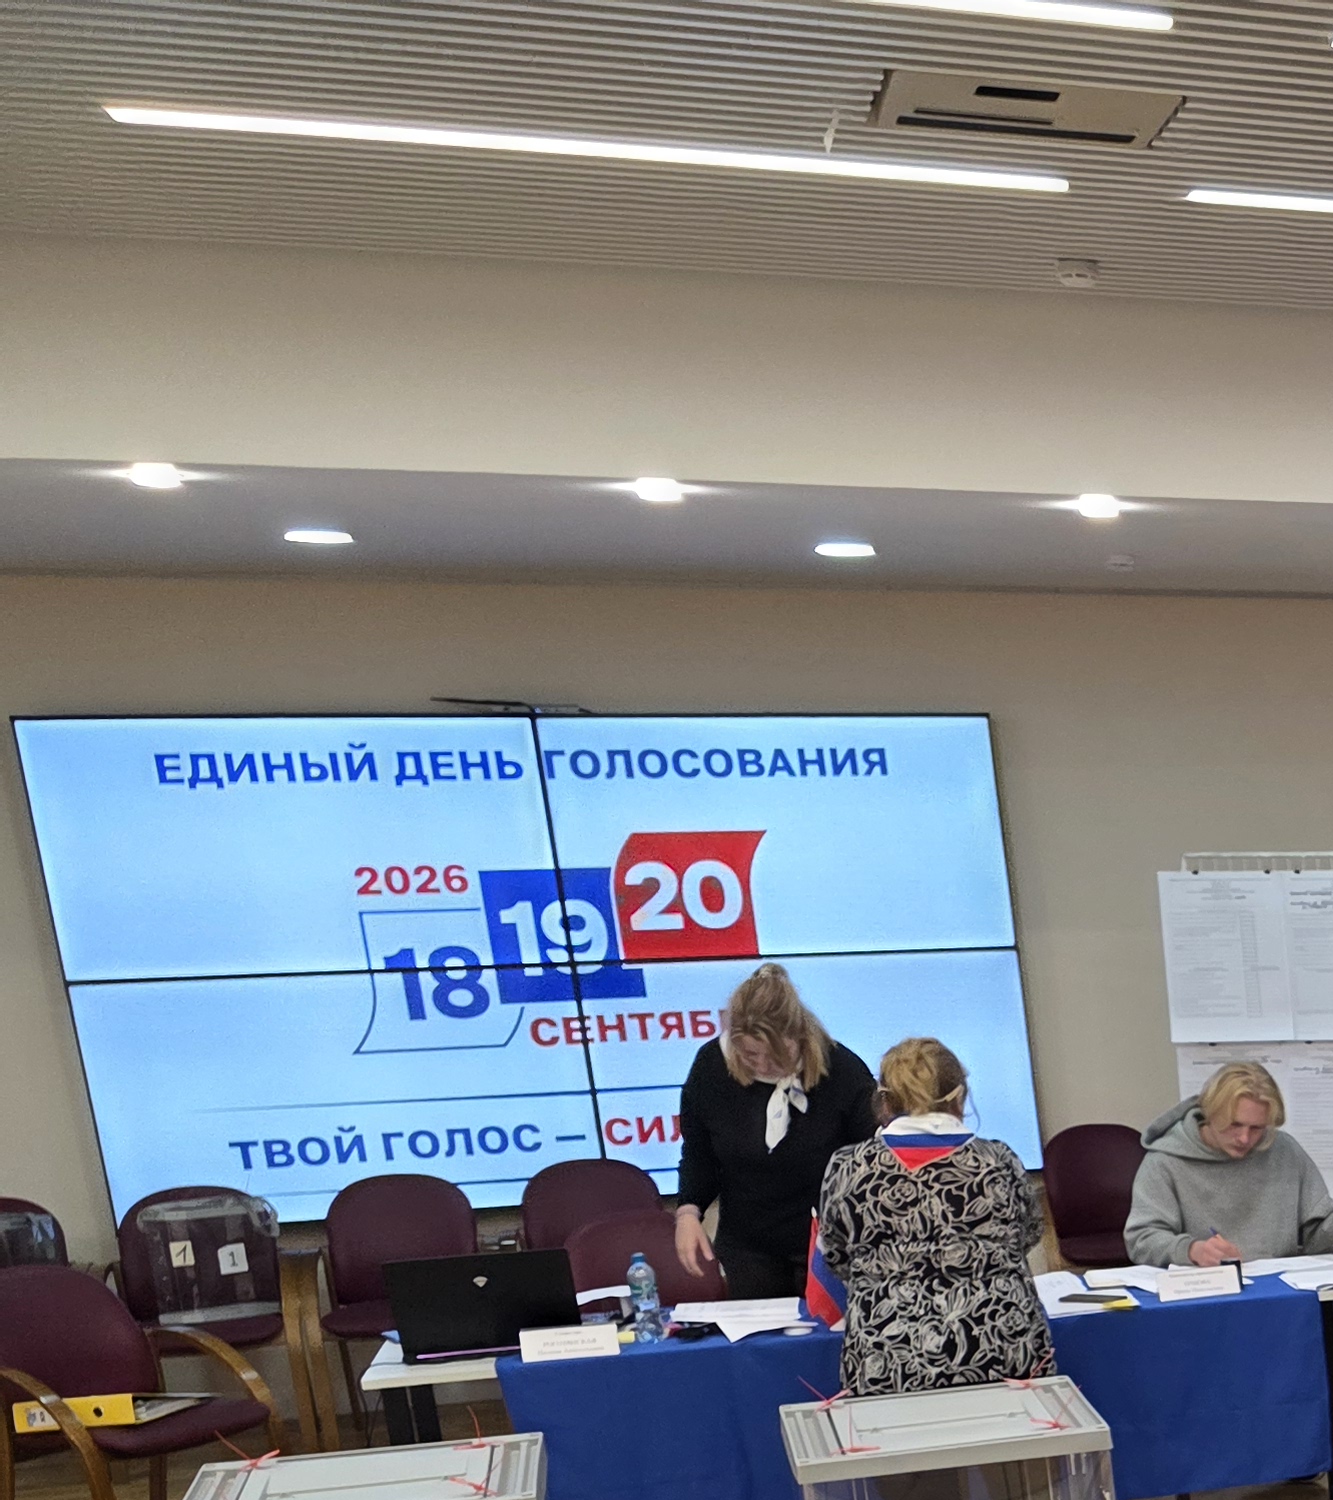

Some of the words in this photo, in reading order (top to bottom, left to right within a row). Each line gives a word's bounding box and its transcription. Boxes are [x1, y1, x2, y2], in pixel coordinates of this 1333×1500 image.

[153, 742, 379, 789] ЕДИНЫЙ
[395, 750, 524, 786] ДЕНЬ
[543, 747, 888, 779] ГОЛОСОВАНИЯ
[353, 864, 469, 896] 2026
[624, 859, 743, 932] 20
[500, 898, 609, 977] 19
[383, 945, 491, 1020] 18
[229, 1126, 367, 1170] ТВОЙ
[383, 1123, 543, 1161] ГОЛОС
[228, 1251, 238, 1267] 1
